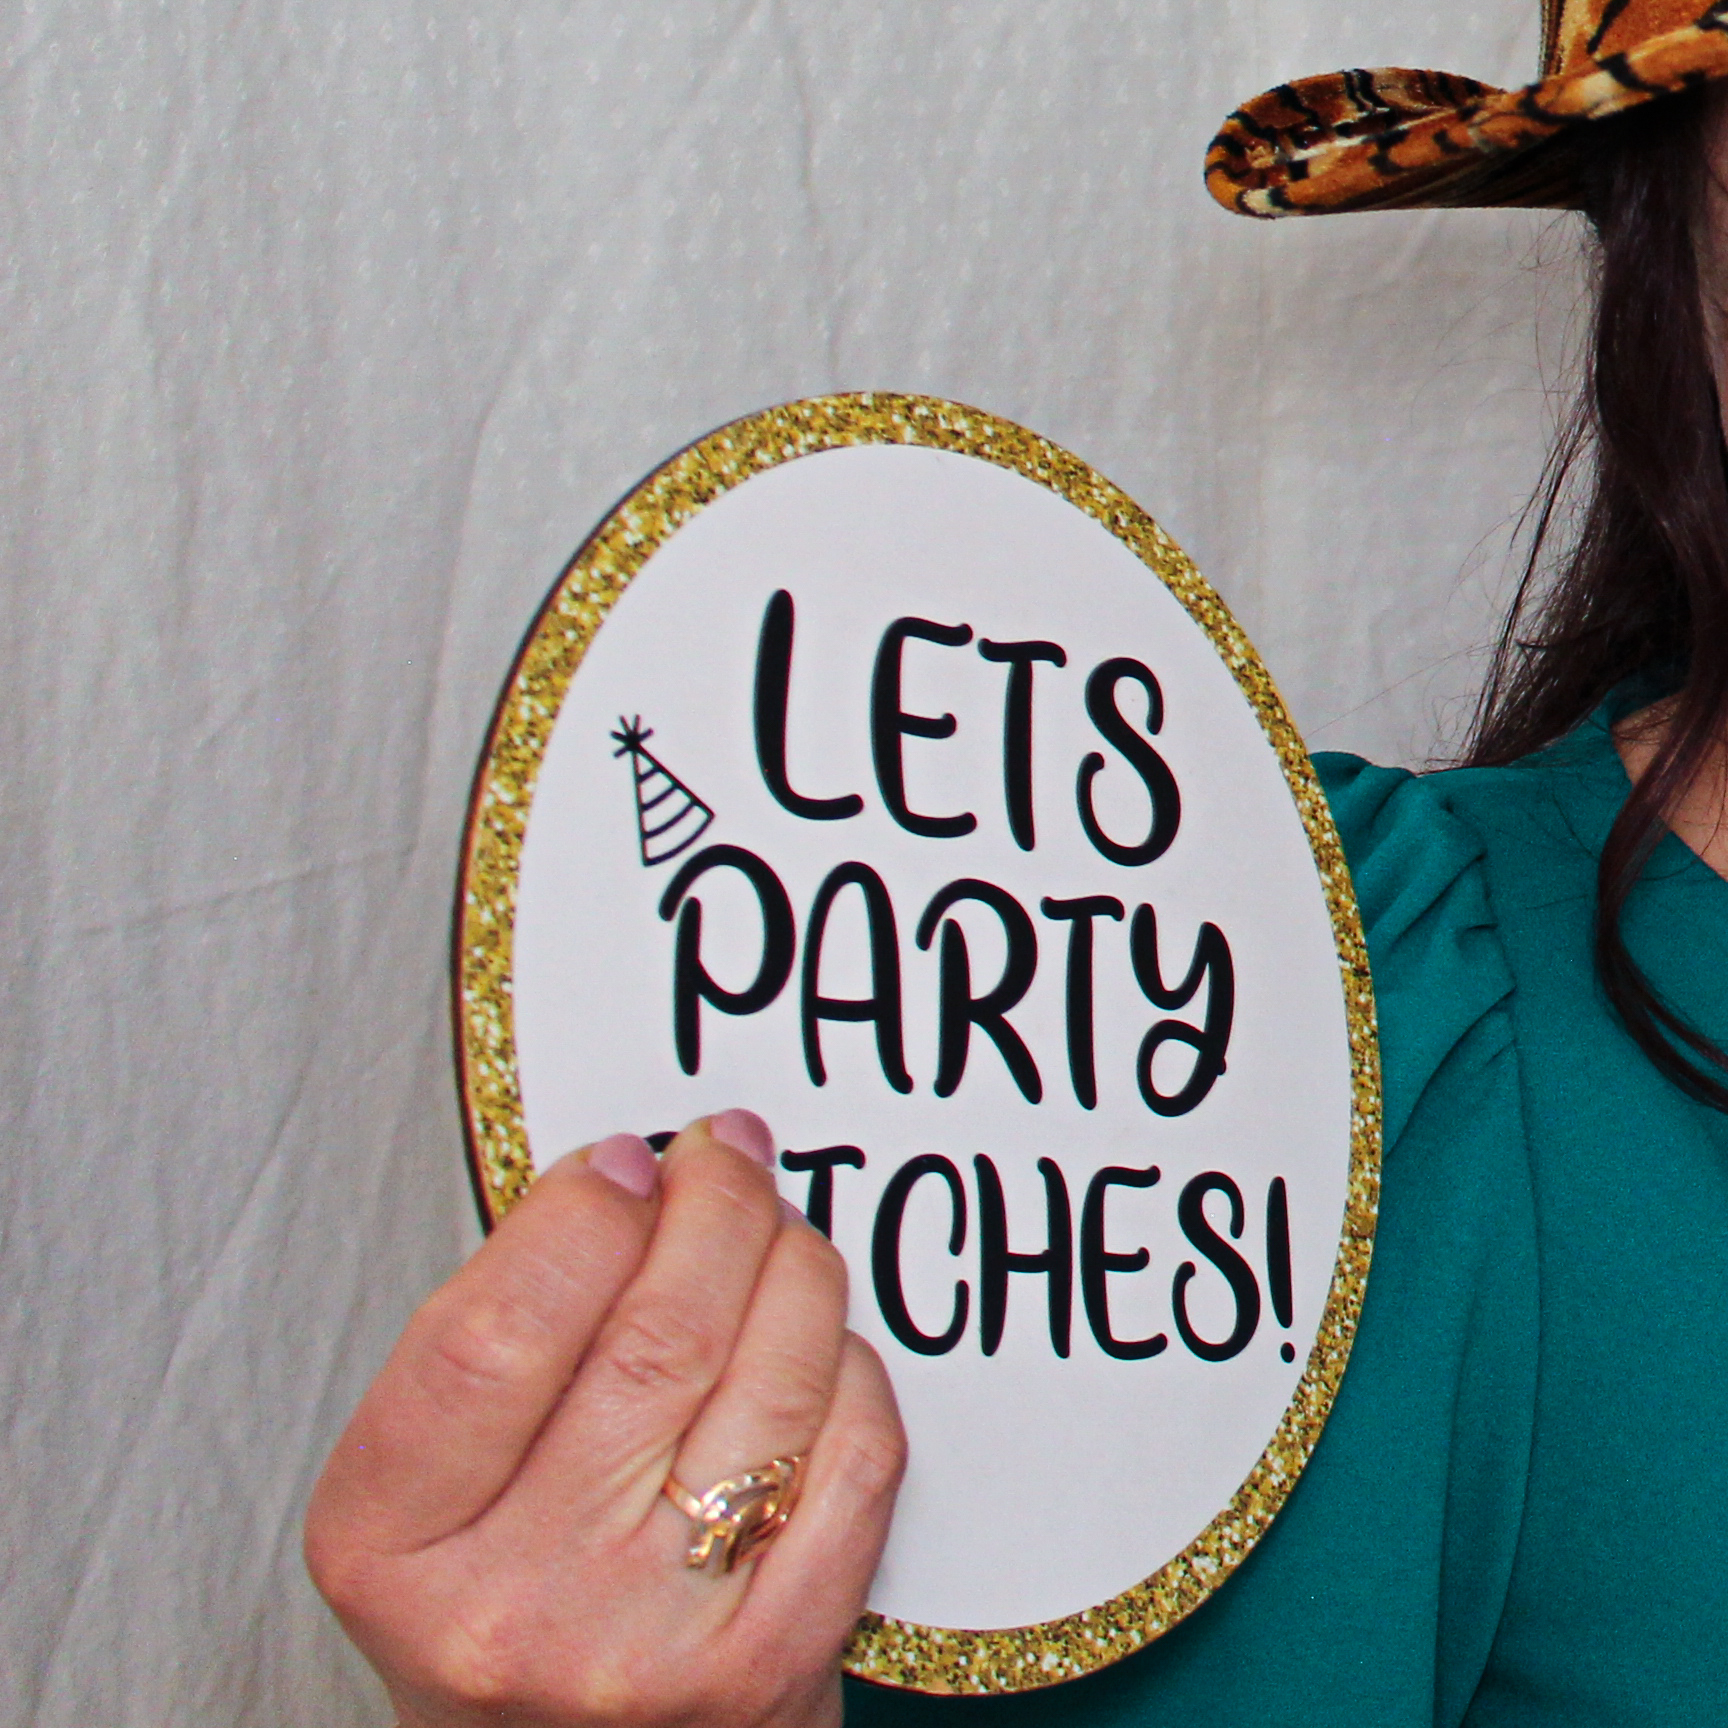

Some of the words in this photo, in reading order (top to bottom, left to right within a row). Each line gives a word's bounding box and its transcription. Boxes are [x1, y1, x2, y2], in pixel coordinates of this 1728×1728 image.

[753, 588, 1182, 868] LETS
[658, 843, 1236, 1118] PARTY
[645, 1131, 1298, 1366] TCHES!
